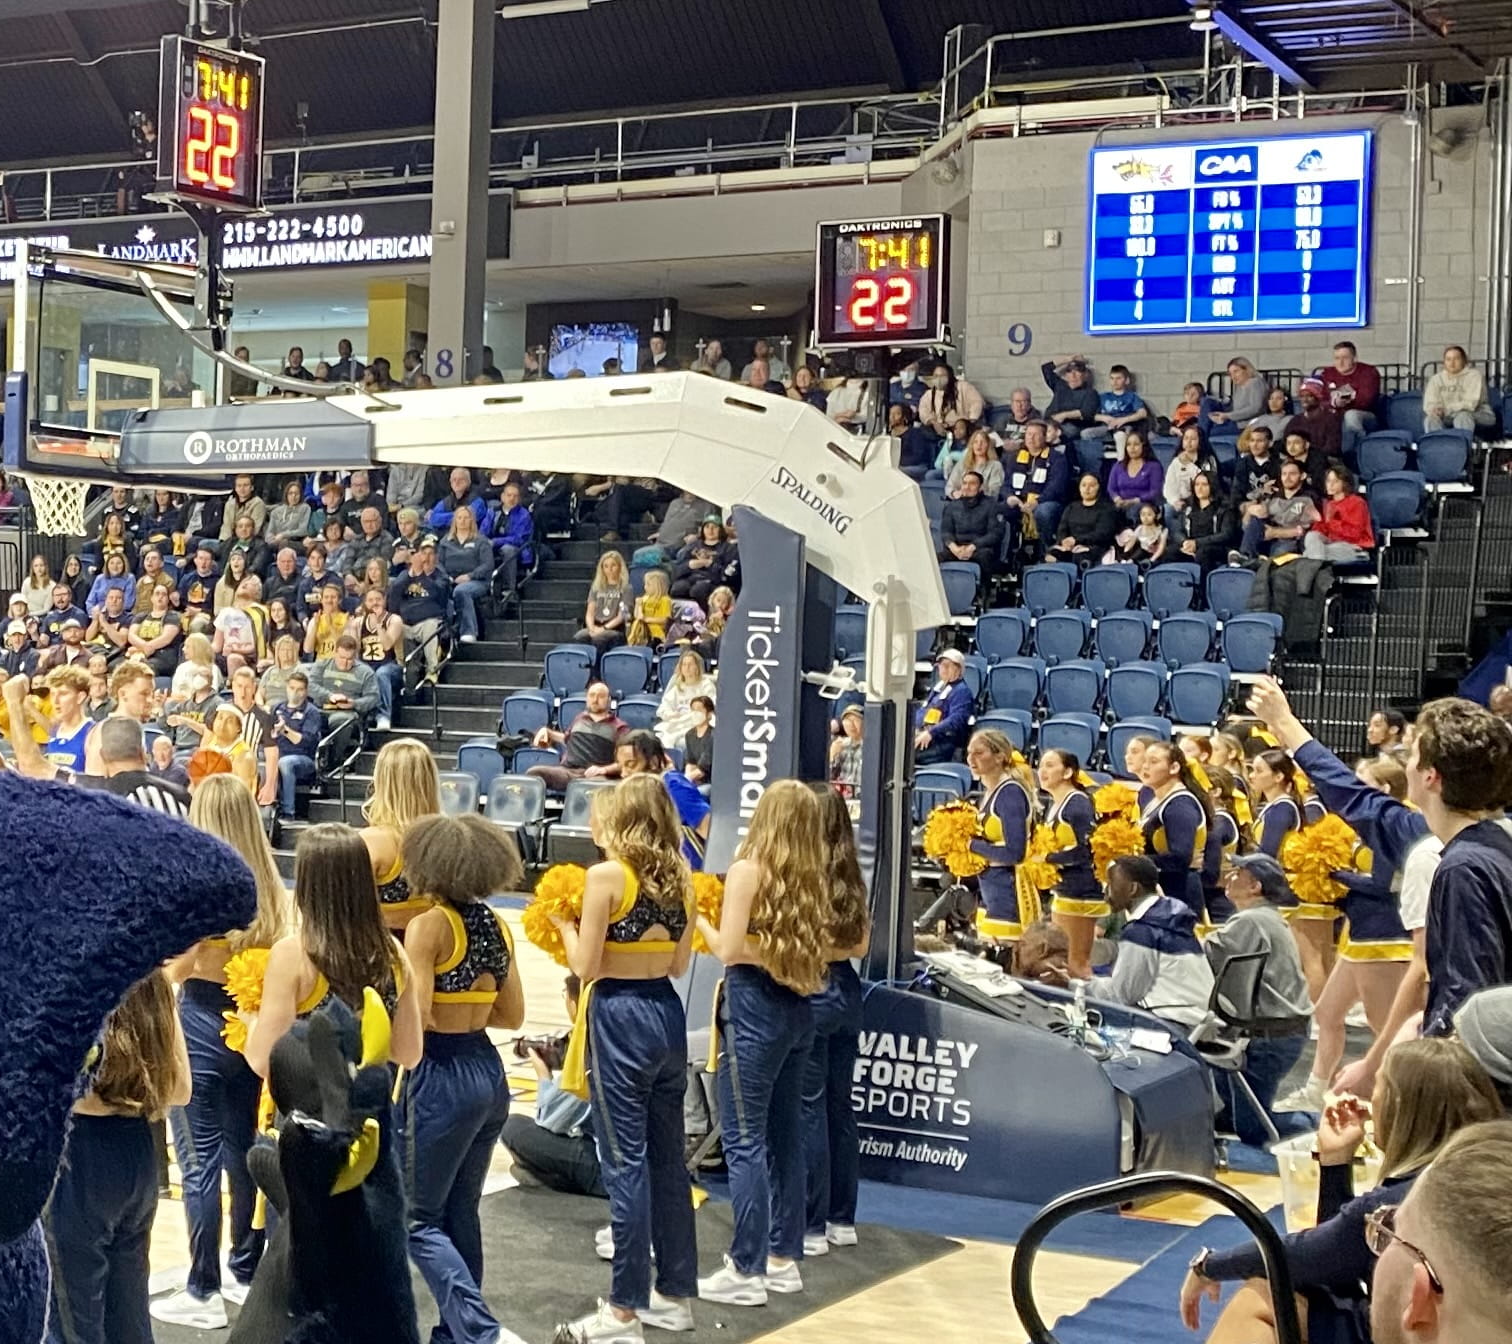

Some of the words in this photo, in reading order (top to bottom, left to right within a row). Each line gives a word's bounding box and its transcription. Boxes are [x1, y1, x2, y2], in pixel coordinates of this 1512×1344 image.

[198, 61, 249, 111] 7:41
[186, 106, 239, 189] 22
[223, 214, 363, 244] 215-222-4500
[839, 219, 923, 233] DAKTRONICS
[859, 236, 930, 272] 7:41
[851, 277, 912, 326] 22
[1007, 322, 1033, 356] 9
[435, 349, 454, 378] 8
[215, 436, 308, 454] ROTHMAN
[225, 452, 294, 462] ORTHOPAEDICS
[771, 466, 854, 536] SPALDING
[858, 1031, 979, 1068] VALLEY
[853, 1058, 958, 1095] FORGE
[850, 1086, 971, 1126] SPORTS
[896, 1141, 968, 1172] Authority
